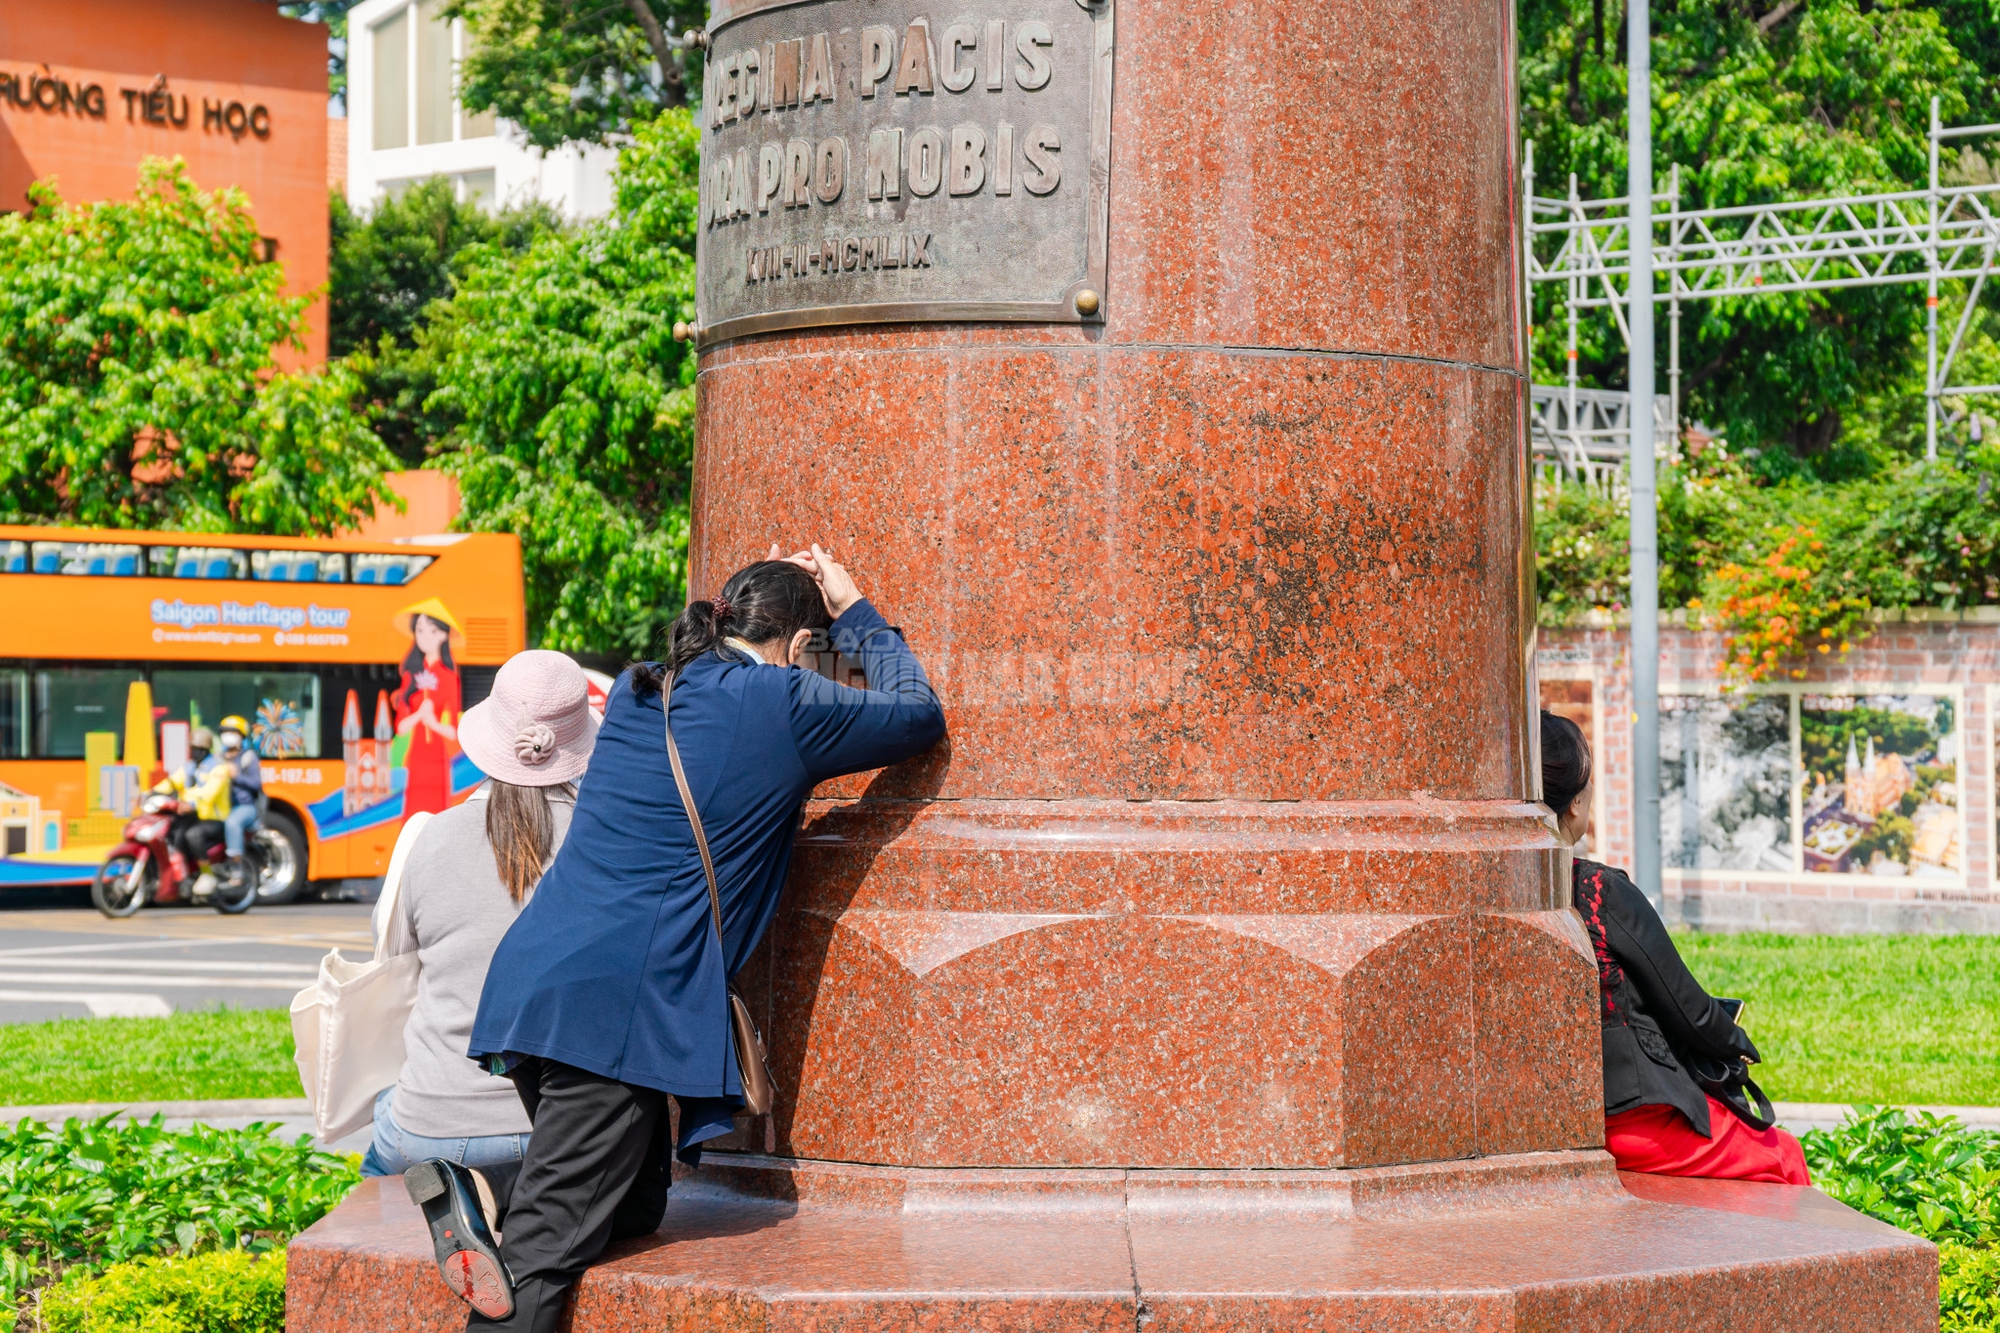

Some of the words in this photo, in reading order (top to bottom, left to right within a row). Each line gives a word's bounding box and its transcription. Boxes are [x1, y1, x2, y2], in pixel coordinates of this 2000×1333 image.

[0, 63, 105, 117] RƯỜNG
[120, 73, 188, 125] TIỂU
[203, 98, 270, 142] HỌC
[710, 33, 835, 130] REGINA
[860, 20, 1053, 97] PACIS
[758, 136, 846, 212] PRO
[867, 126, 1062, 200] NOBIS
[151, 599, 219, 629] Saigon
[221, 601, 305, 631] Heritage
[307, 603, 350, 628] tour
